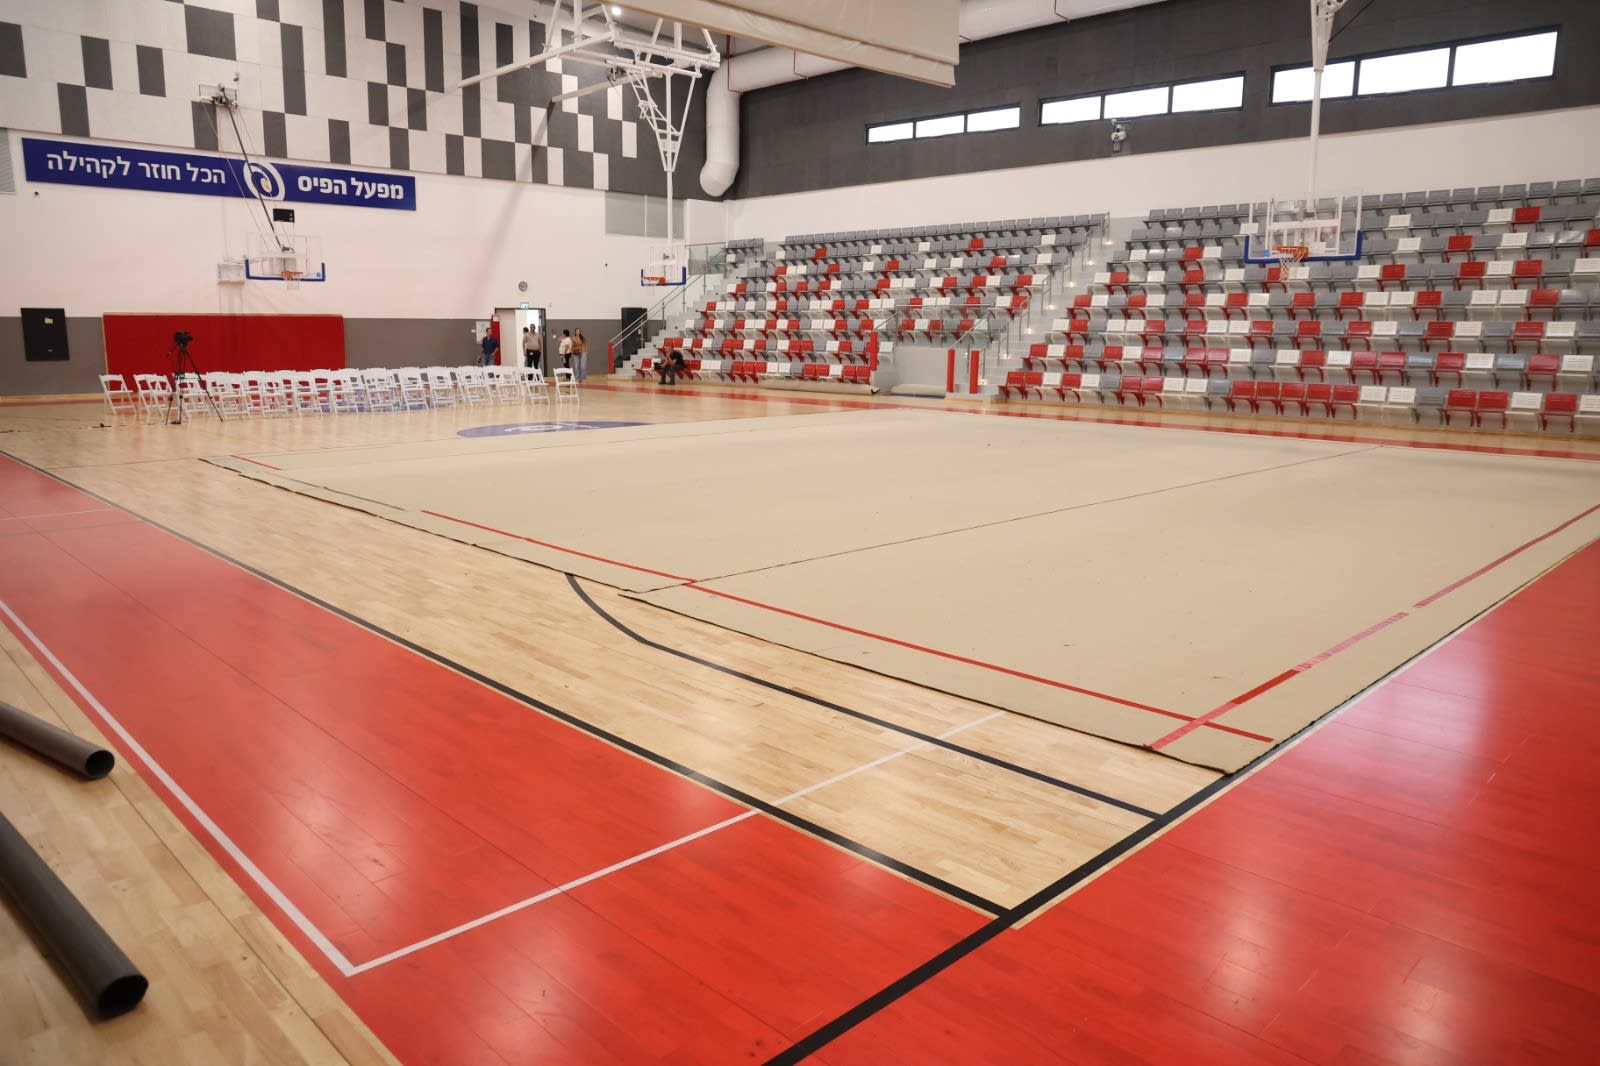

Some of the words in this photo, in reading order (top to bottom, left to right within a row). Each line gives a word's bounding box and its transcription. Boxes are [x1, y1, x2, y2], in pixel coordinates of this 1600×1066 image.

[46, 150, 131, 179] לקהילה
[137, 161, 181, 181] חוזר
[186, 162, 226, 184] הכל
[297, 175, 348, 196] הפיס
[350, 176, 404, 200] מפעל
